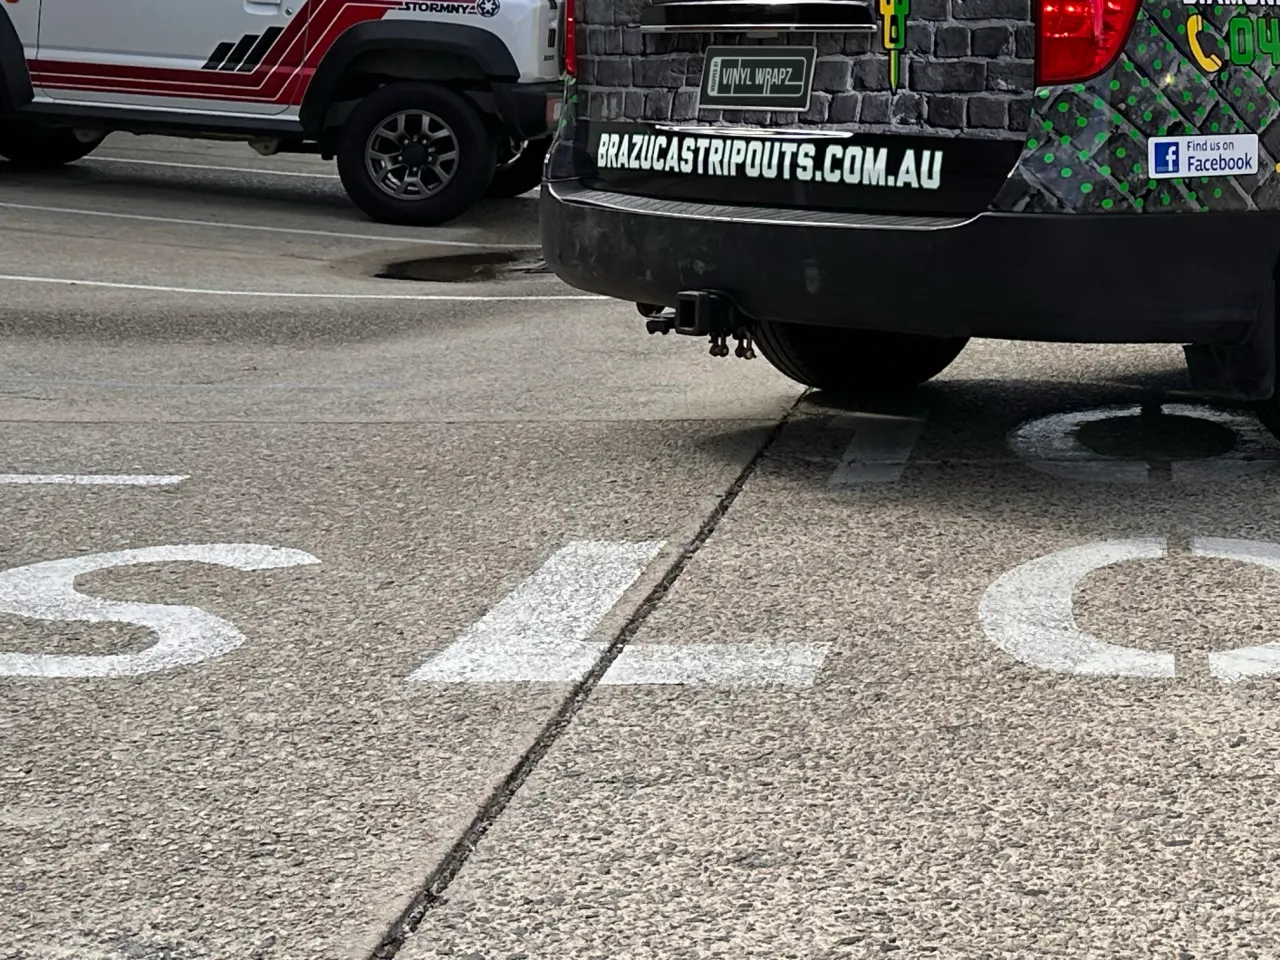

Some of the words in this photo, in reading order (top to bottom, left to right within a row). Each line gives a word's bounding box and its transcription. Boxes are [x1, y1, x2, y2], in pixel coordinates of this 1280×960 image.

[723, 66, 752, 88] VINYL
[755, 67, 794, 88] WRAPZ
[1187, 141, 1208, 152] Find
[1210, 141, 1221, 151] us
[1222, 141, 1234, 151] on
[598, 133, 943, 189] BRAZUCASTRIPOUTS.COM.AU
[1187, 153, 1253, 172] Facebook
